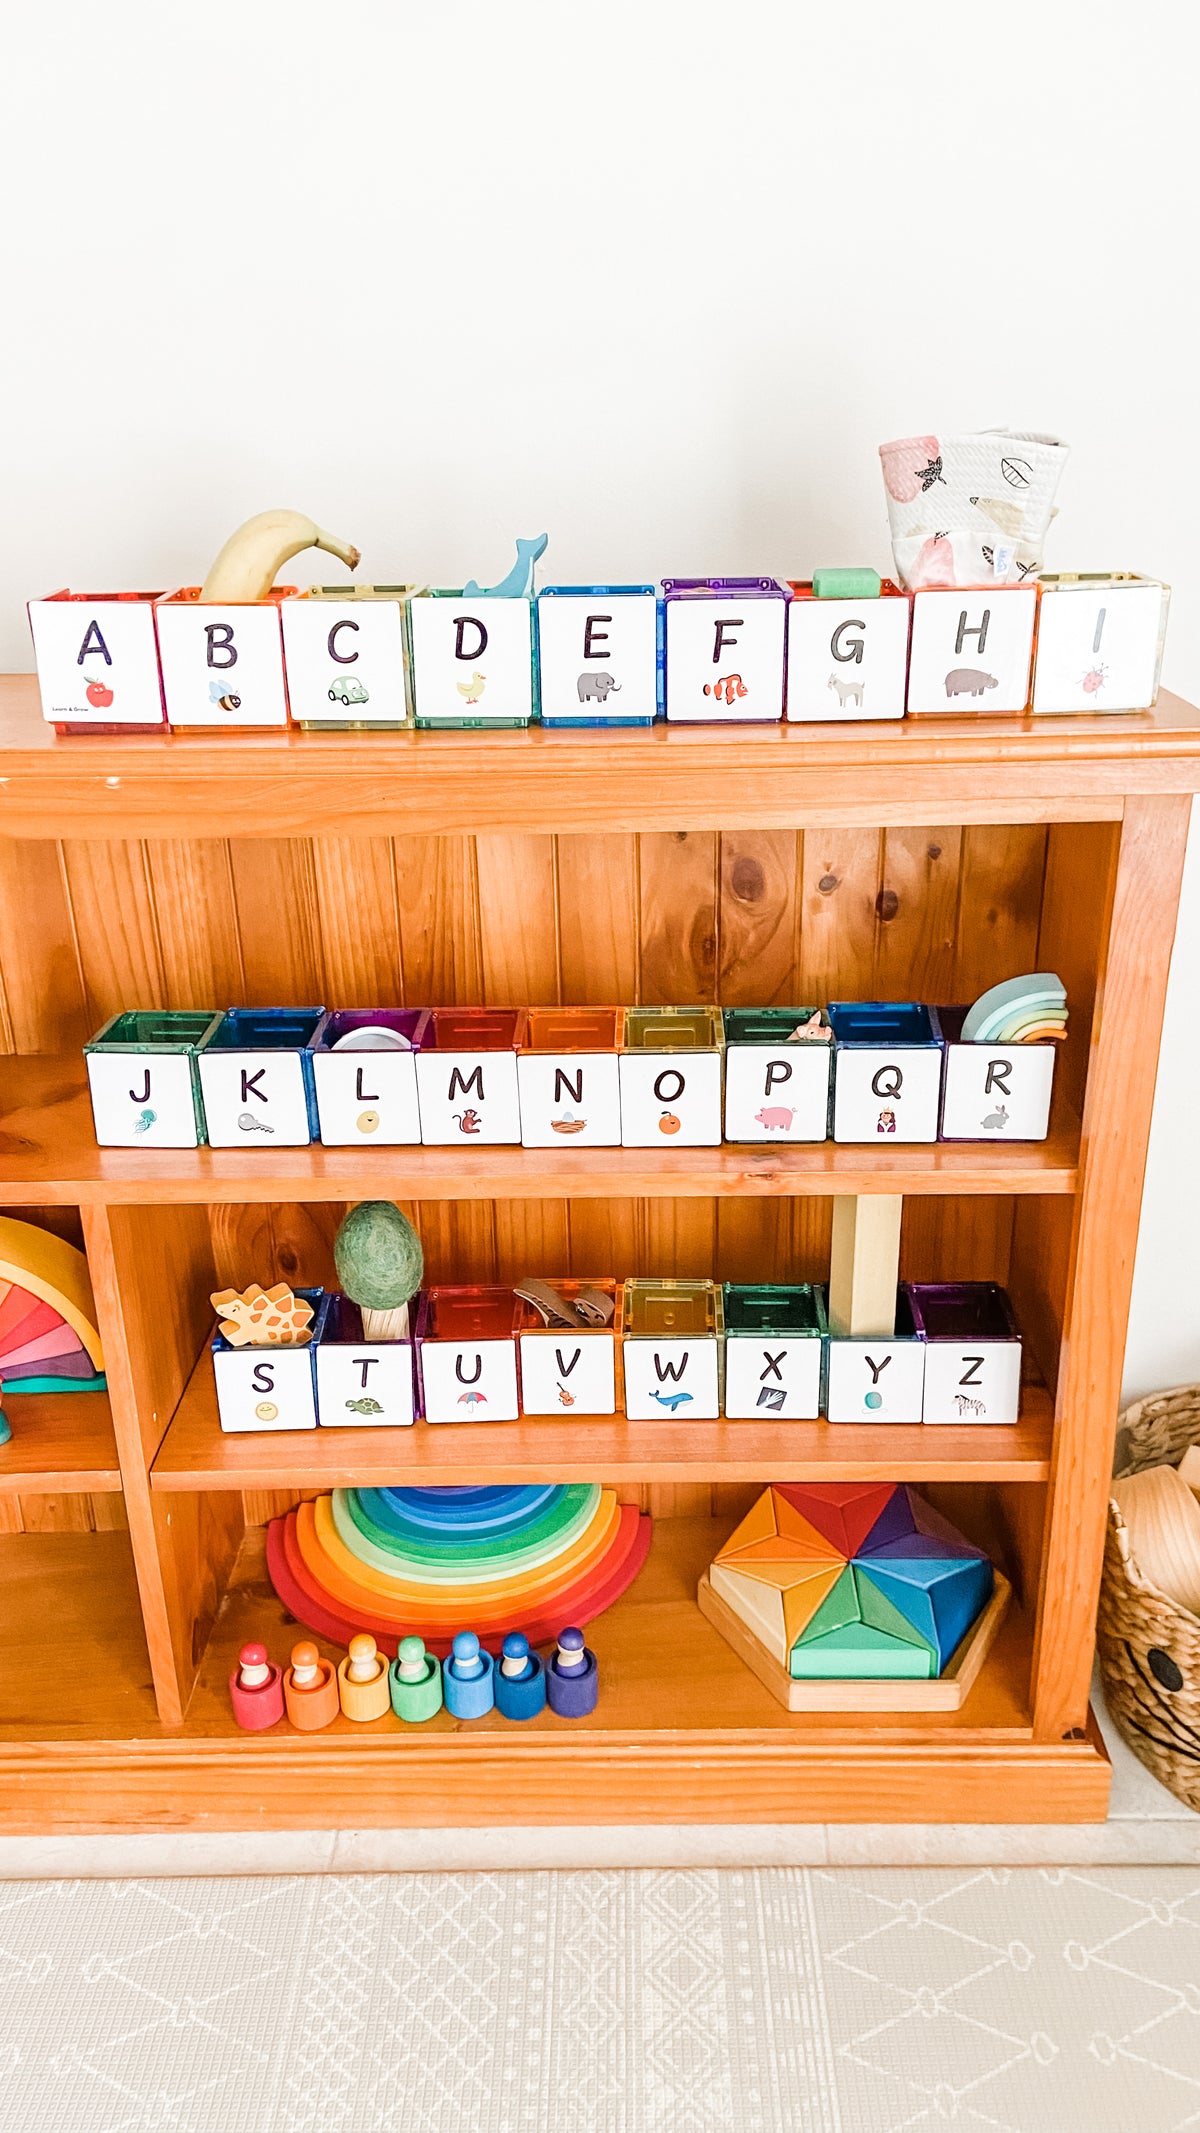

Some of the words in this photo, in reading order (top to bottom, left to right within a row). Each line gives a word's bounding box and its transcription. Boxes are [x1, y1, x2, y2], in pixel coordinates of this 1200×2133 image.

[78, 620, 112, 665] A
[204, 624, 237, 668] B
[328, 621, 359, 663] C
[453, 617, 488, 660] D
[584, 616, 612, 658] E
[713, 620, 744, 663] F
[831, 620, 865, 664] G
[955, 610, 990, 654] H
[1093, 608, 1106, 653] I
[129, 1069, 150, 1102] J
[241, 1069, 268, 1102] K
[357, 1068, 379, 1100] L
[449, 1066, 484, 1100] M
[555, 1069, 582, 1103] N
[654, 1070, 685, 1102] O
[765, 1061, 792, 1096] P
[872, 1066, 902, 1099] Q
[985, 1060, 1012, 1095] R
[252, 1364, 274, 1393] S
[352, 1359, 379, 1387] T
[456, 1355, 481, 1384] U
[556, 1349, 581, 1377] V
[654, 1352, 688, 1381] W
[760, 1351, 787, 1380] X
[865, 1356, 891, 1384] Y
[959, 1357, 984, 1385] Z
